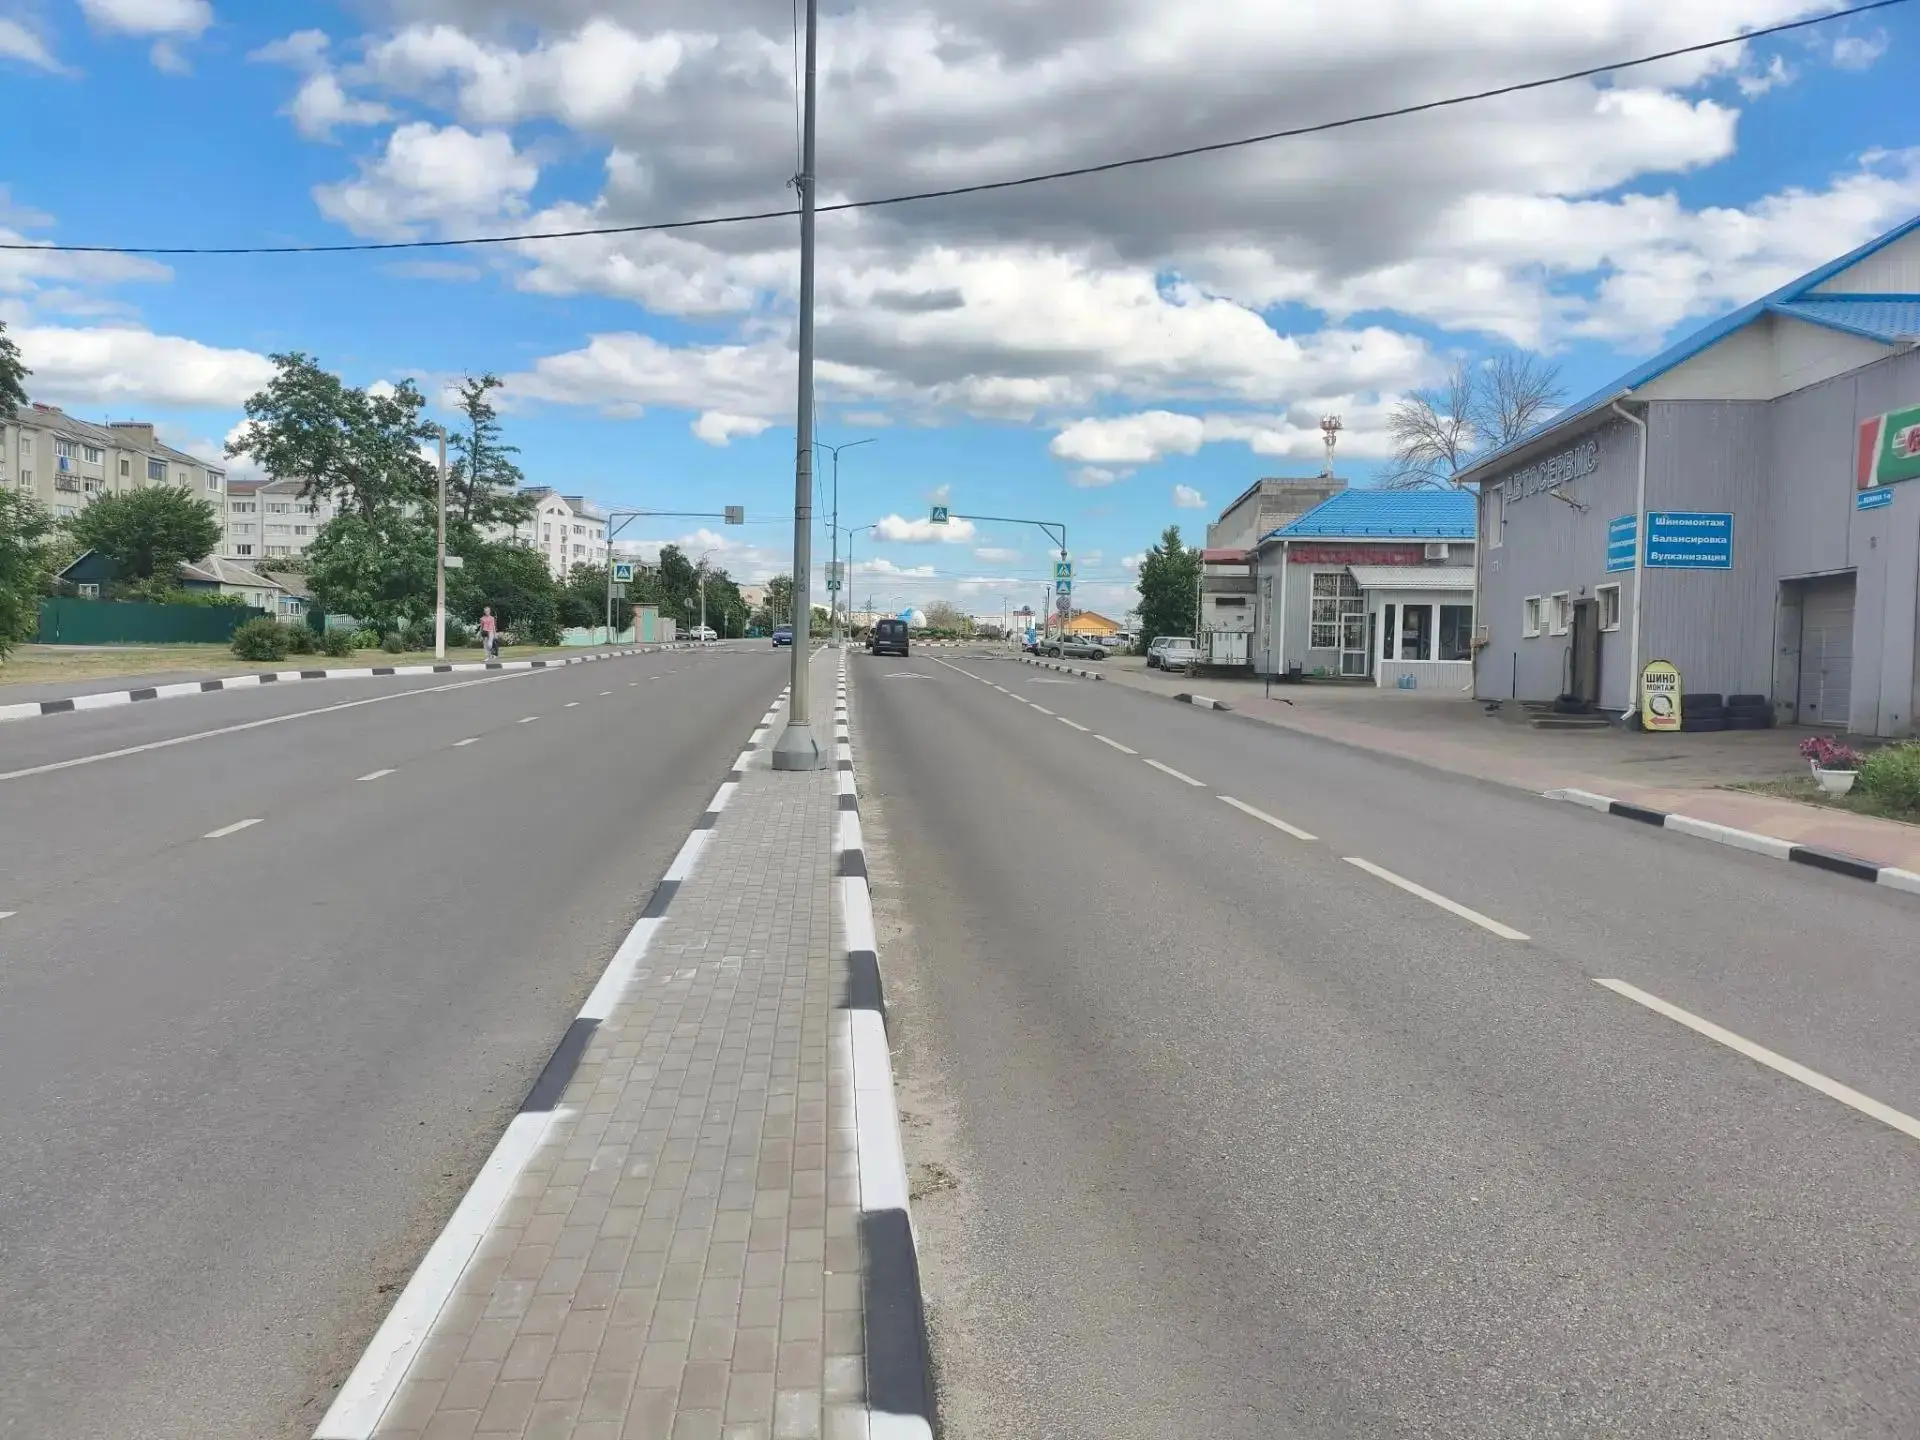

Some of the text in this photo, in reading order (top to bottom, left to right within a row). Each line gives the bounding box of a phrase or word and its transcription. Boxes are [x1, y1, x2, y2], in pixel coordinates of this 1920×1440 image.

[1506, 440, 1599, 503] АВТОСЕРВИС
[1655, 516, 1725, 527] Шиномонтаж
[1651, 534, 1728, 545] Балансировка
[1650, 551, 1727, 562] Вулканизация
[1646, 673, 1676, 684] ШИНО
